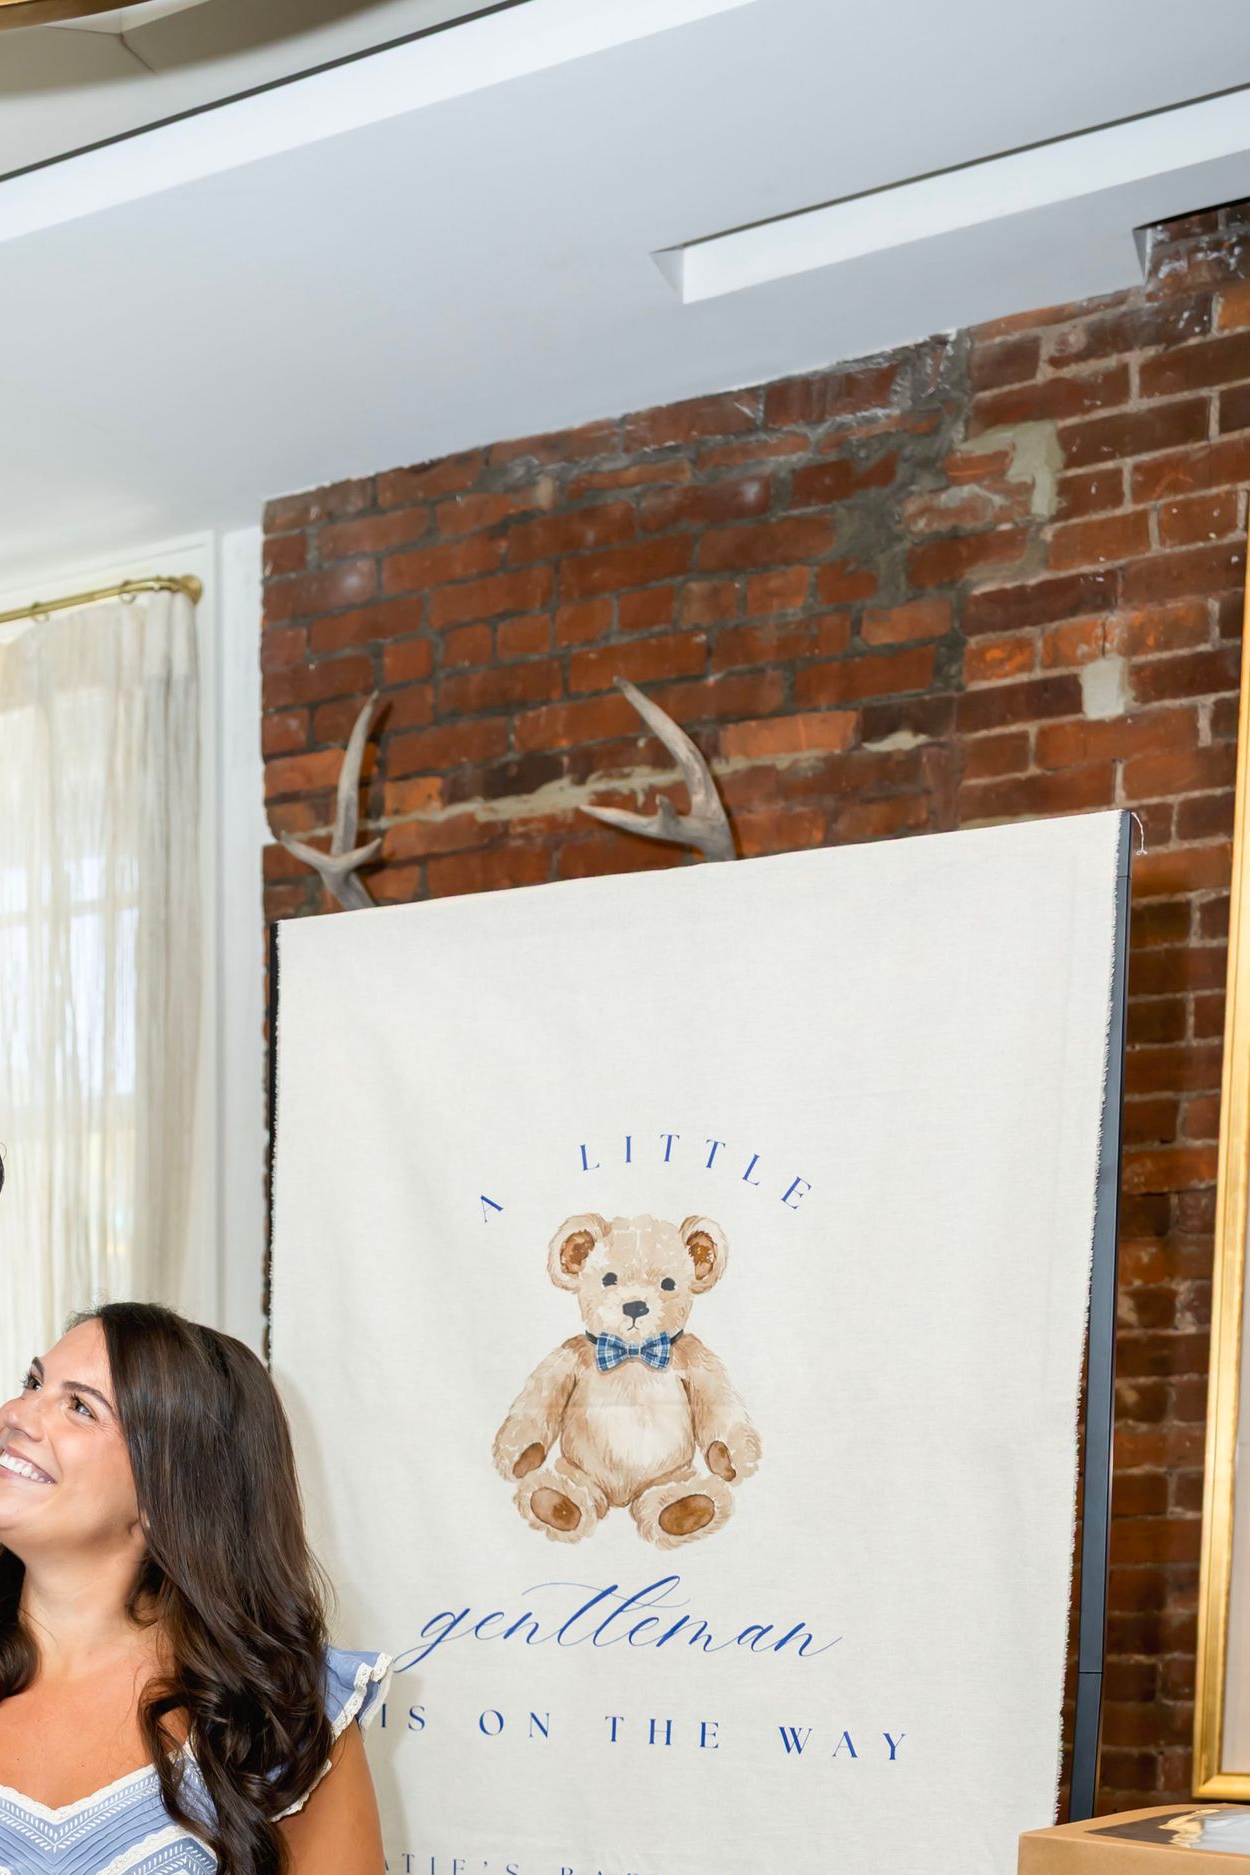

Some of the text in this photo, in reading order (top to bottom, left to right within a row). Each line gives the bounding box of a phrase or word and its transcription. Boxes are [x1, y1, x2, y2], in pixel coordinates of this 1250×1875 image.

[479, 1132, 812, 1223] A LITTLE
[393, 1574, 844, 1674] gentleman
[380, 1702, 908, 1762] IS ON THE WAY
